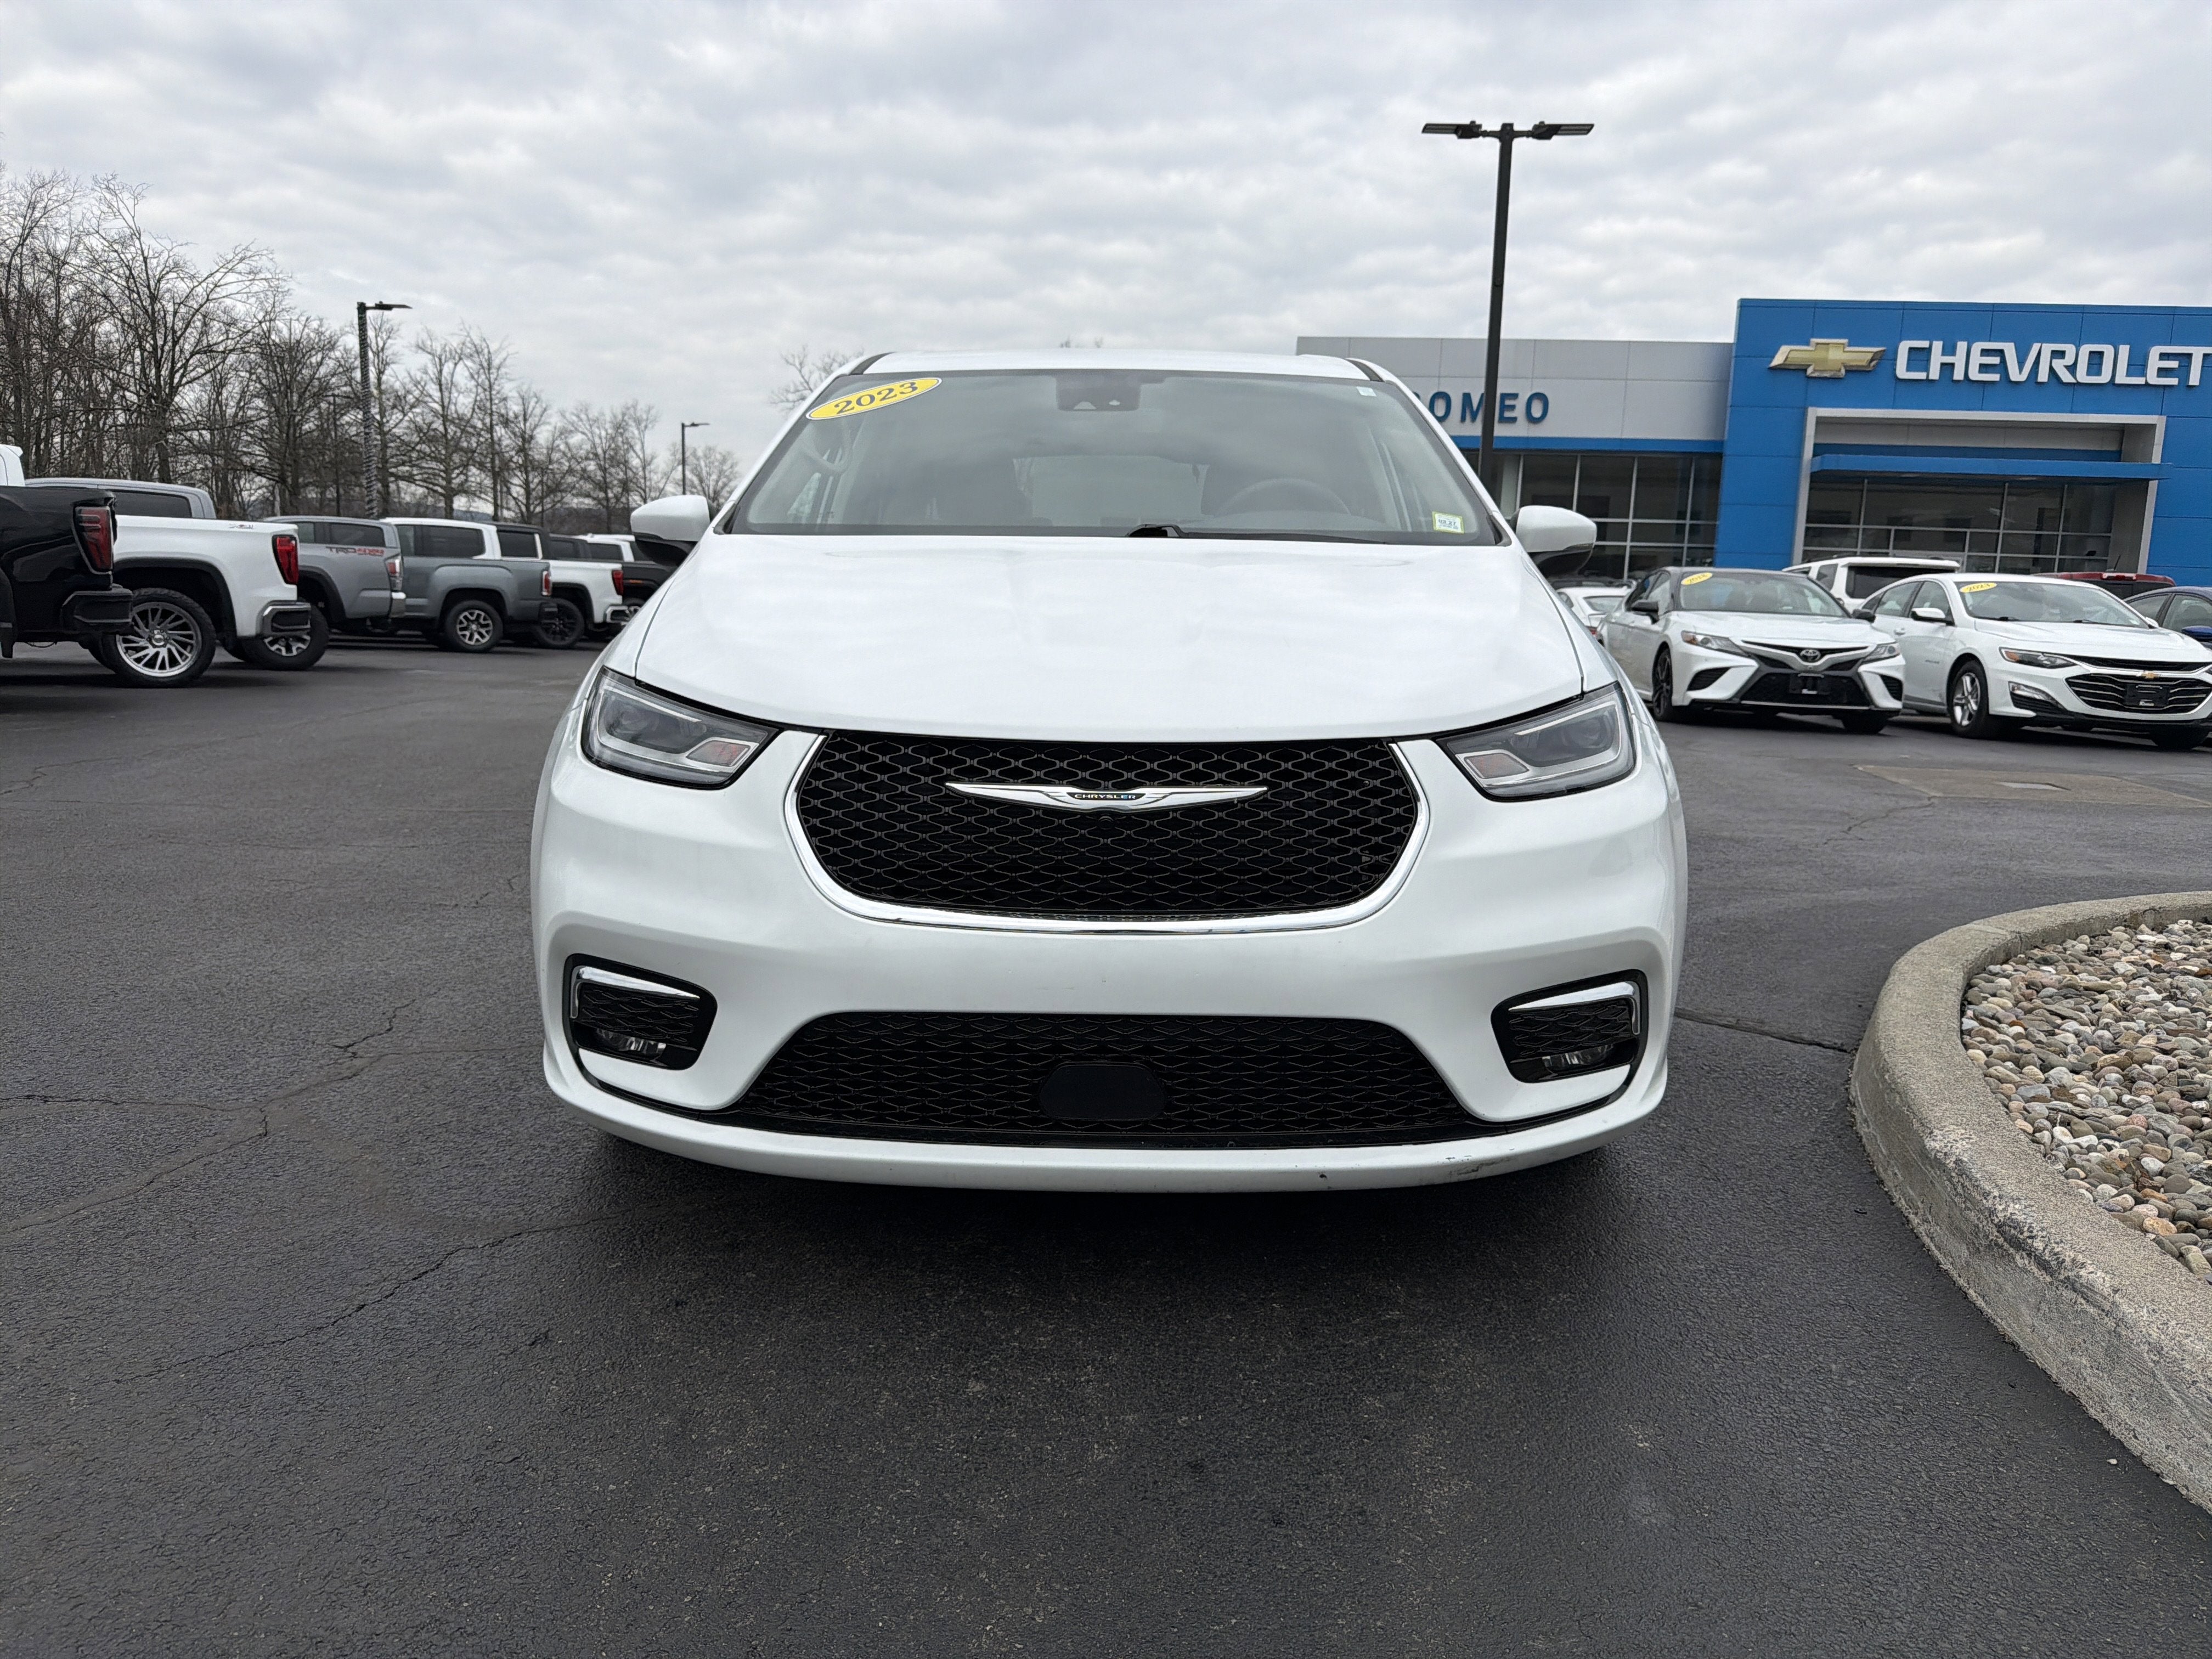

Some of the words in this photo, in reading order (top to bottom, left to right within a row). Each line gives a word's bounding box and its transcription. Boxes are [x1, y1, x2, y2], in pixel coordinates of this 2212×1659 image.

[1896, 340, 2212, 386] CHEVROLET
[834, 382, 918, 414] 2023
[1413, 391, 1549, 424] OMEO
